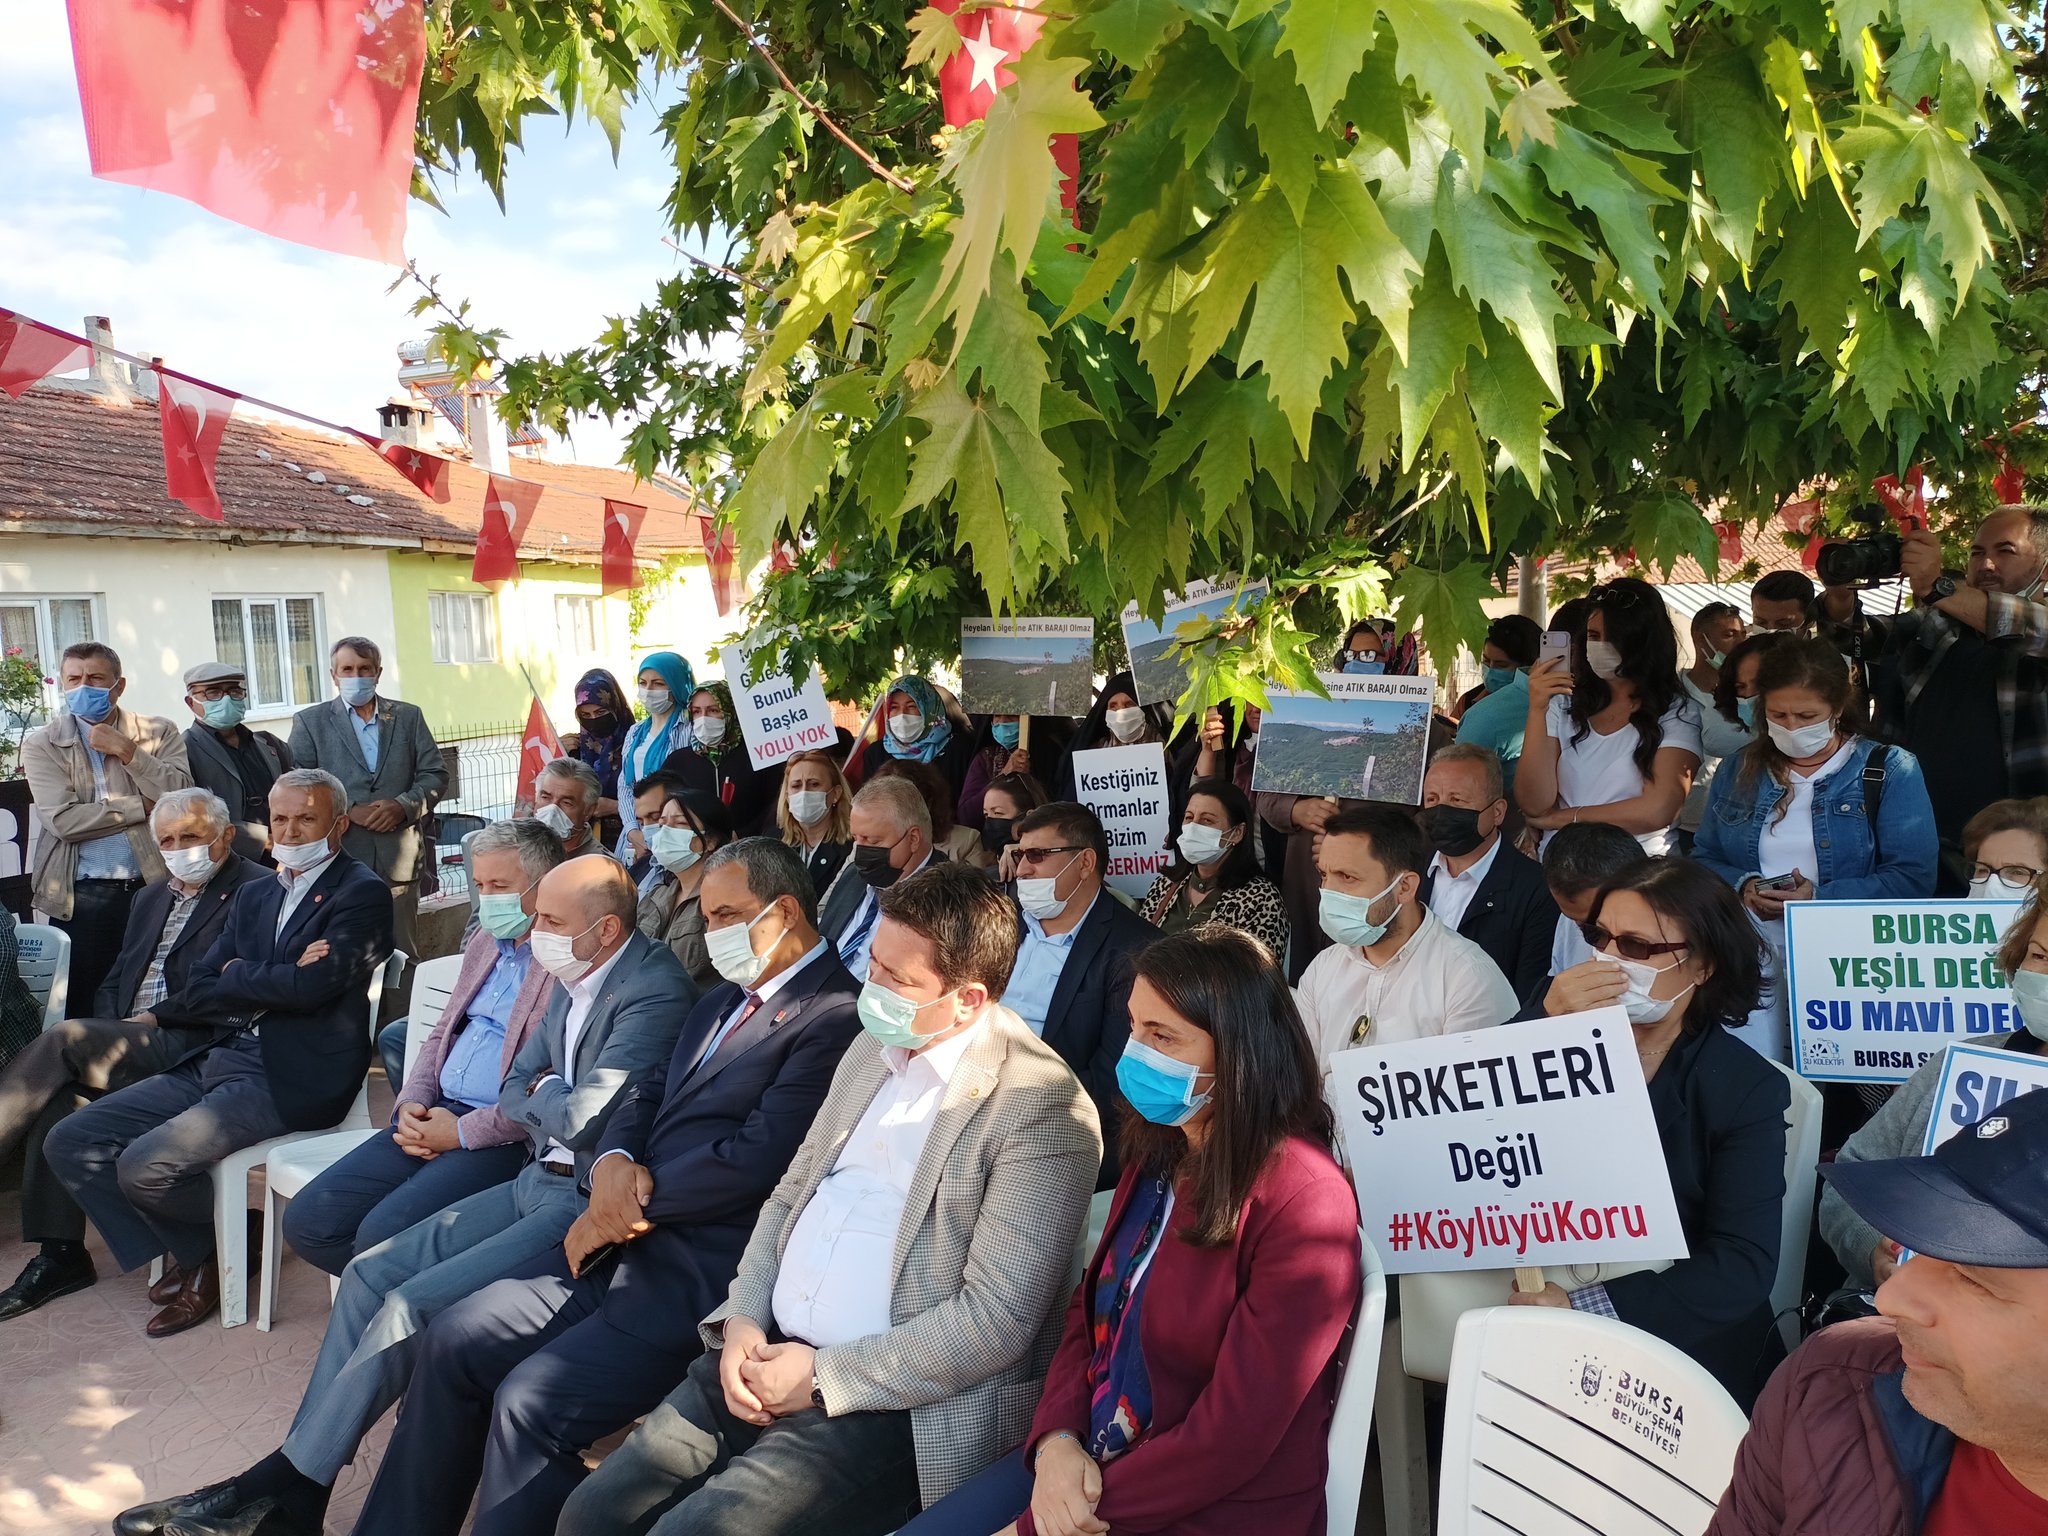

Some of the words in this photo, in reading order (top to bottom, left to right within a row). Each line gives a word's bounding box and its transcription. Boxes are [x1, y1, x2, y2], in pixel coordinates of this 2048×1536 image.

[1192, 587, 1209, 599] ATIK
[1211, 580, 1236, 595] BARAJI
[963, 623, 991, 633] Heyelan
[1028, 623, 1043, 632] ATIK
[1045, 623, 1068, 633] BARAJI
[1069, 623, 1091, 633] Olmaz
[1345, 683, 1365, 693] ATIK
[1367, 683, 1397, 695] BARAJI
[1399, 684, 1428, 695] Olmaz
[761, 708, 809, 733] Başka
[754, 735, 795, 761] YOLU
[797, 723, 830, 747] YOK
[1080, 767, 1159, 792] Kestiğiniz
[1104, 827, 1147, 847] Bizim
[18, 938, 43, 947] BURSA
[1872, 913, 1998, 945] BURSA
[1829, 952, 1925, 994] YEŞİL
[1805, 999, 1852, 1031] SU
[1861, 996, 1954, 1033] MAVİ
[1854, 1050, 1914, 1068] BURSA
[1357, 1028, 1616, 1136] ŞİRKETLERİ
[1448, 1132, 1543, 1189] Değil
[1389, 1200, 1648, 1258] #KöylüyüKoru
[1618, 1369, 1683, 1426] BURSA
